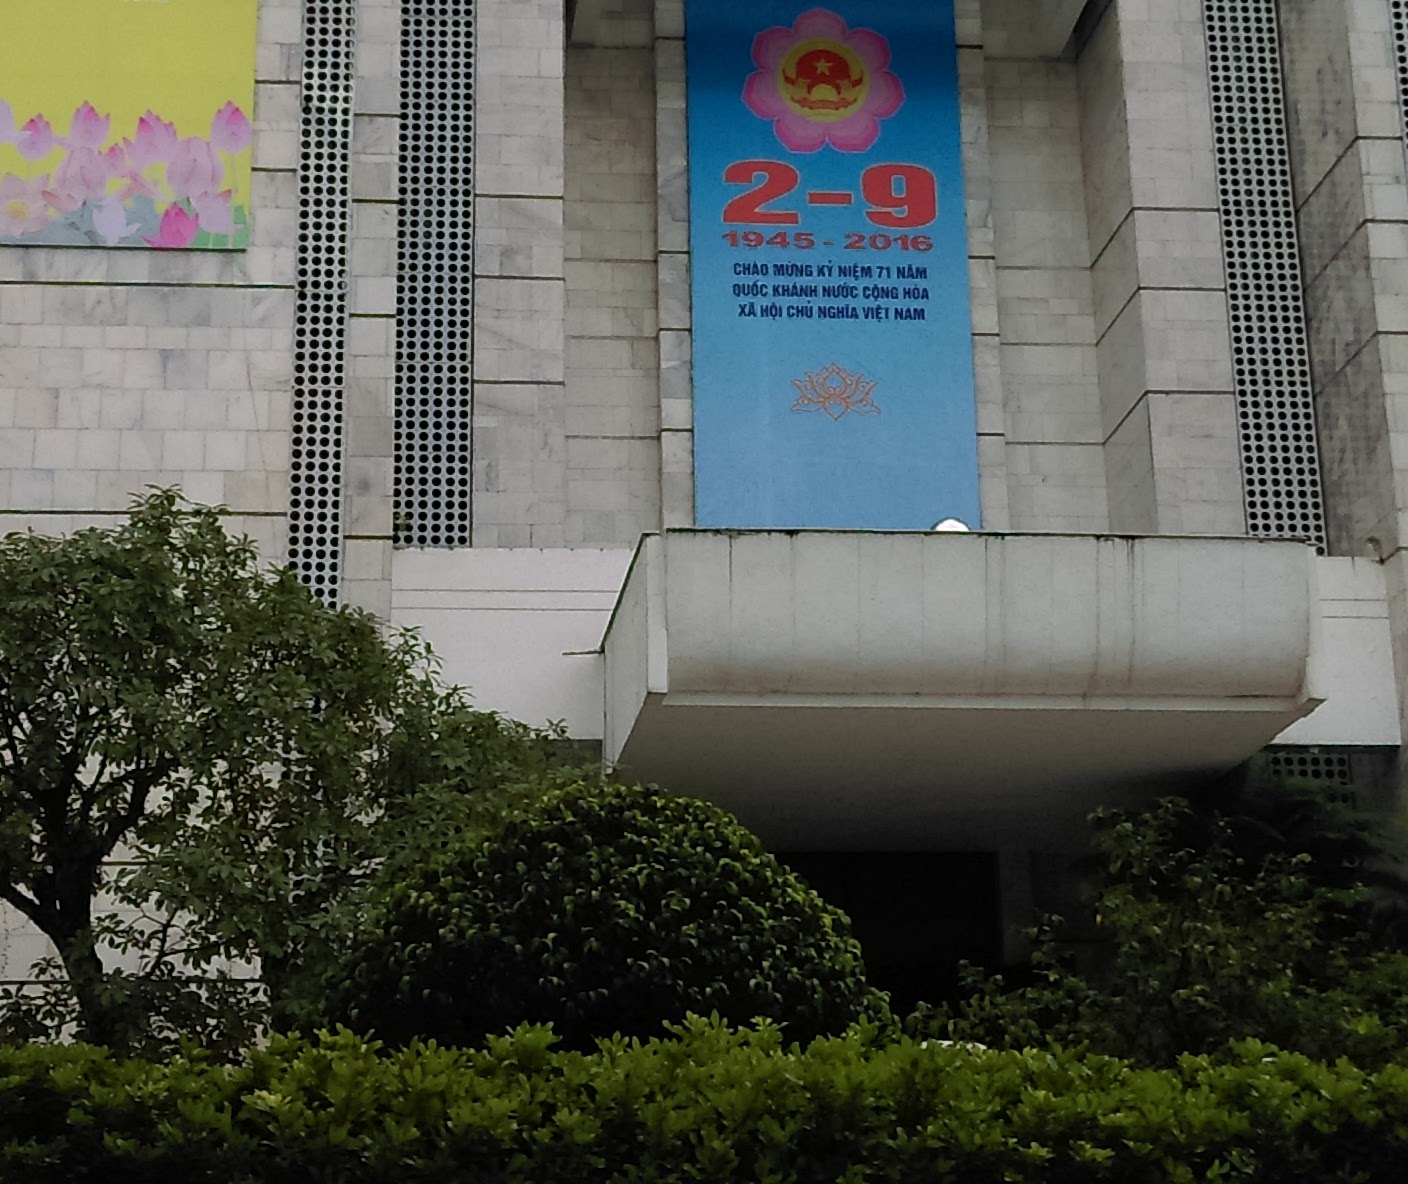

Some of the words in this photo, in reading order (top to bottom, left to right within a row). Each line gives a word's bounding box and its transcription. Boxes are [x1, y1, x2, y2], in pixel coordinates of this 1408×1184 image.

[722, 158, 937, 229] 2-9
[721, 230, 815, 249] 1945
[844, 232, 933, 252] 2016
